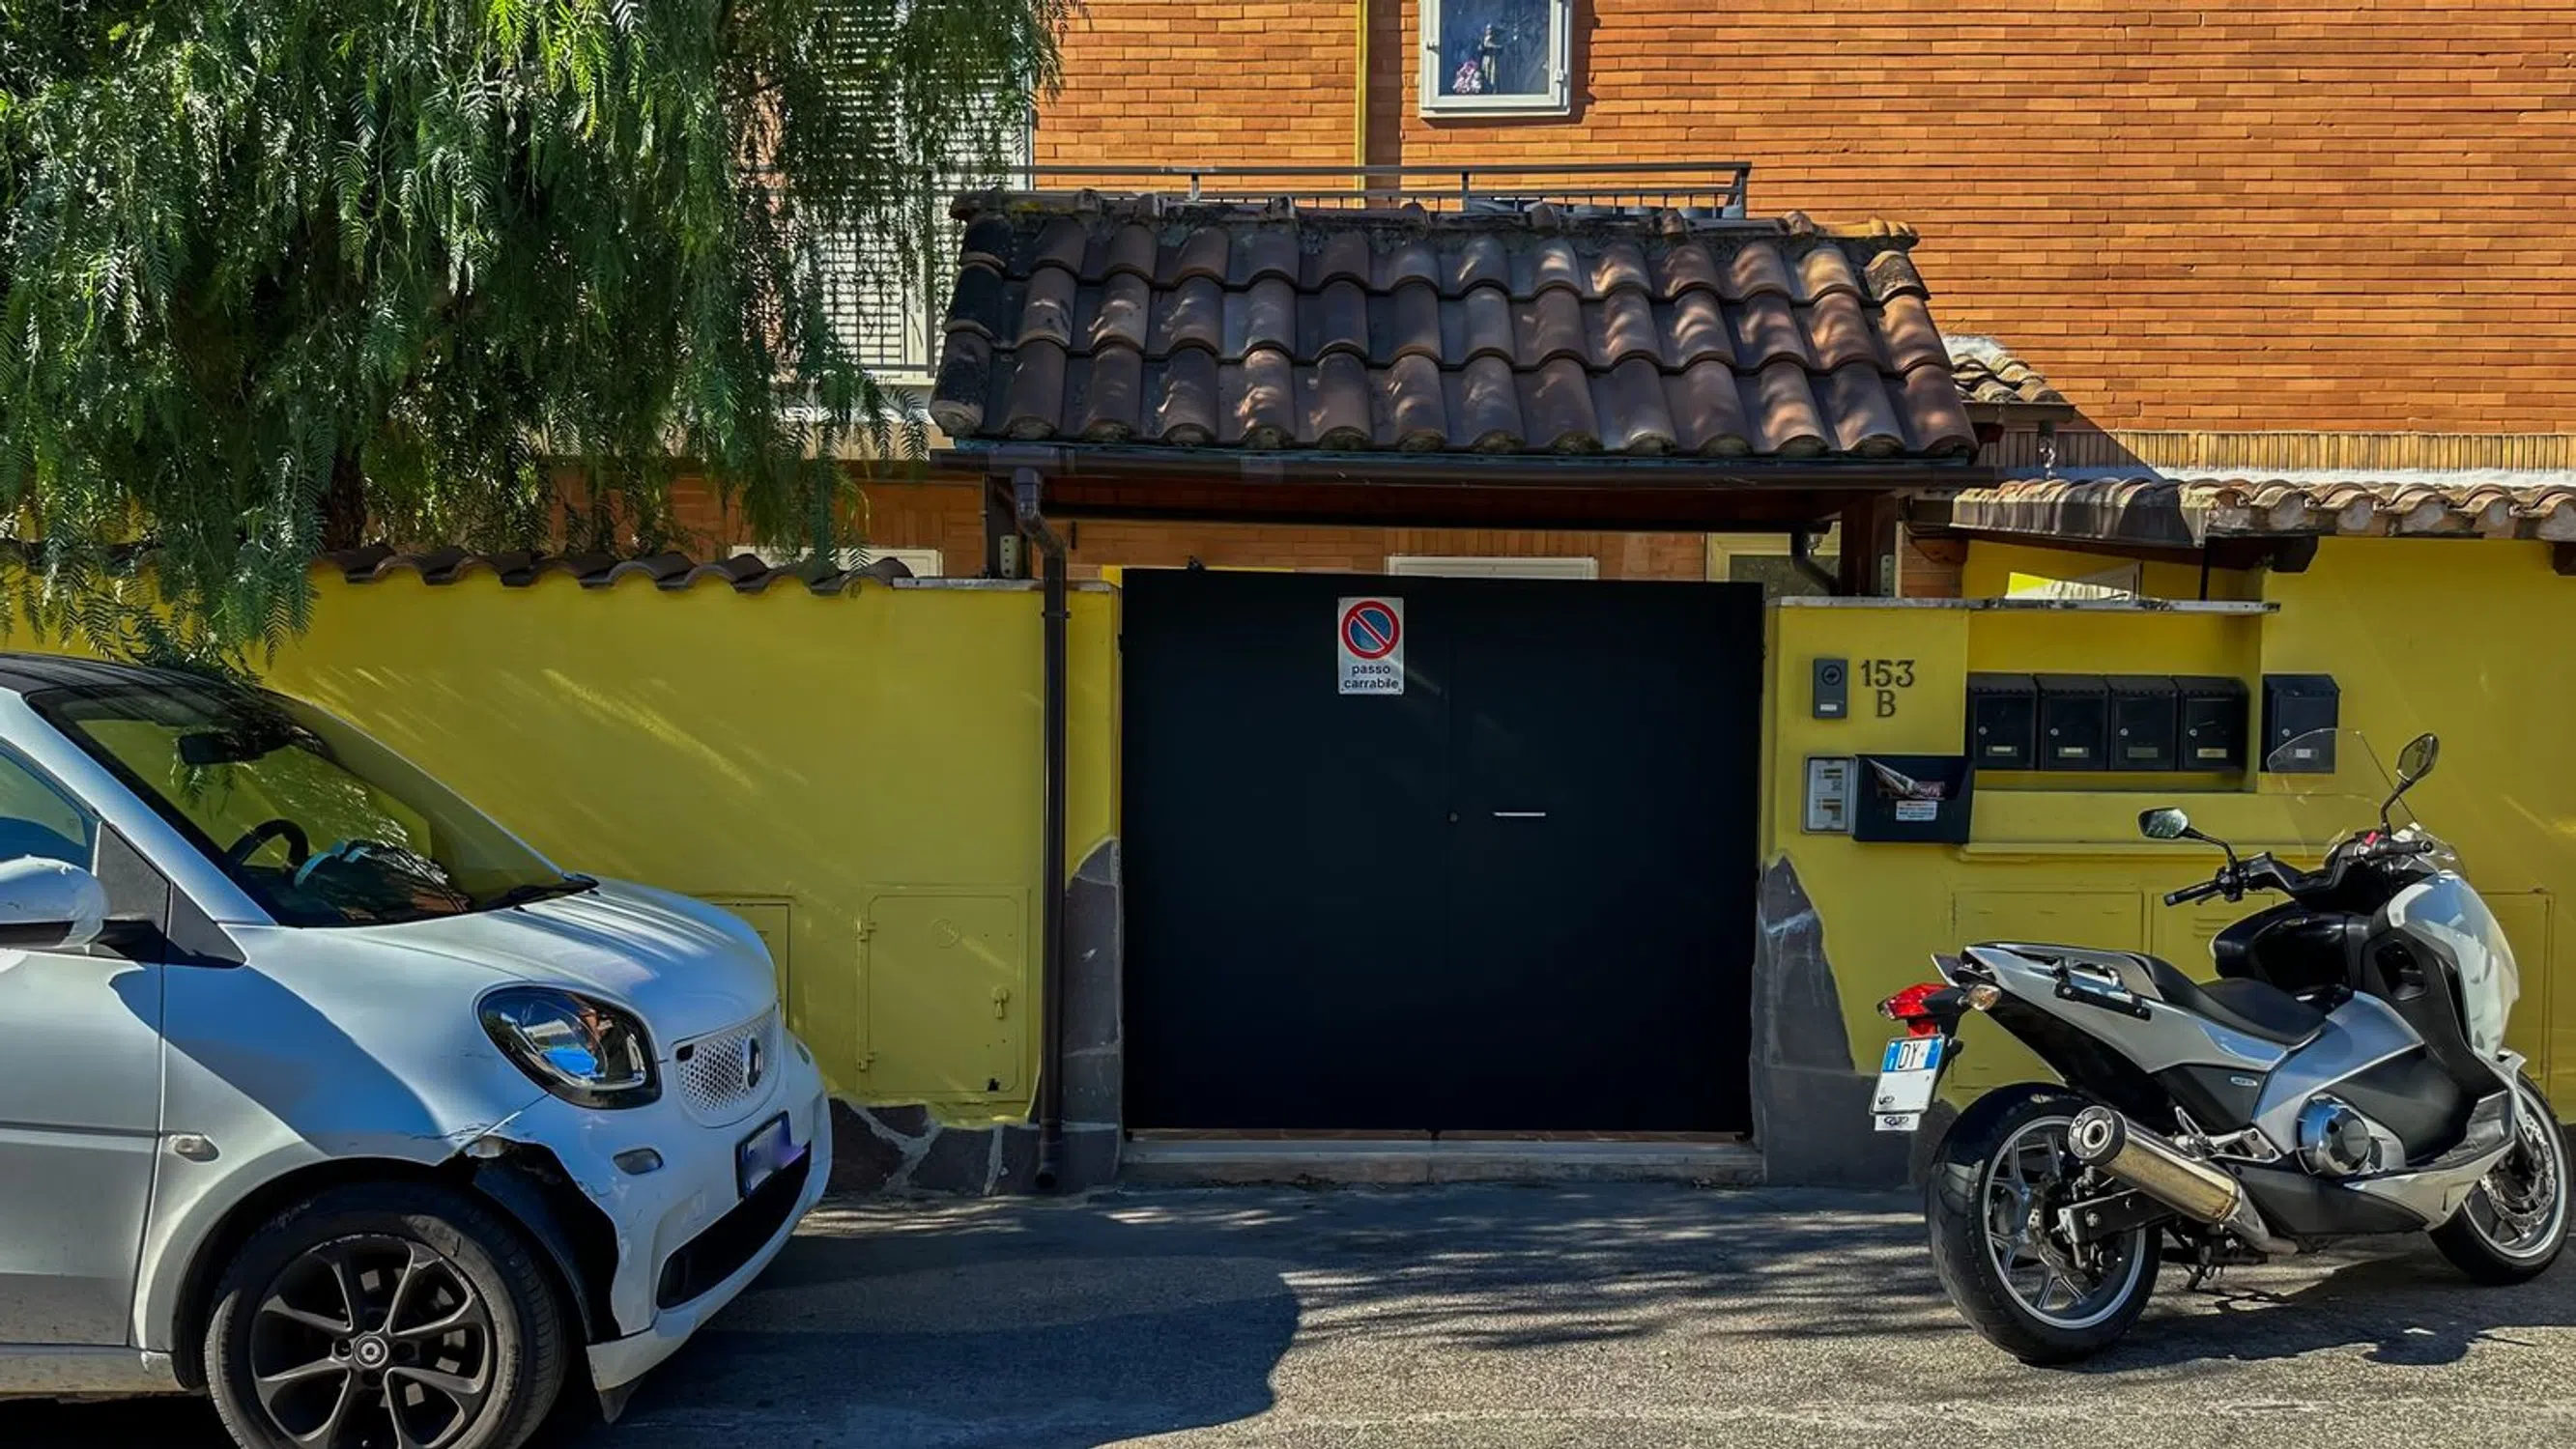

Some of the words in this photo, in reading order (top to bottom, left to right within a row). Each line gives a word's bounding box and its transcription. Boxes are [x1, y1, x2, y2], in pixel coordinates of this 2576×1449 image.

[1352, 665, 1390, 675] passo
[1860, 659, 1915, 688] 153
[1344, 678, 1399, 689] carrabile
[1875, 690, 1896, 717] B
